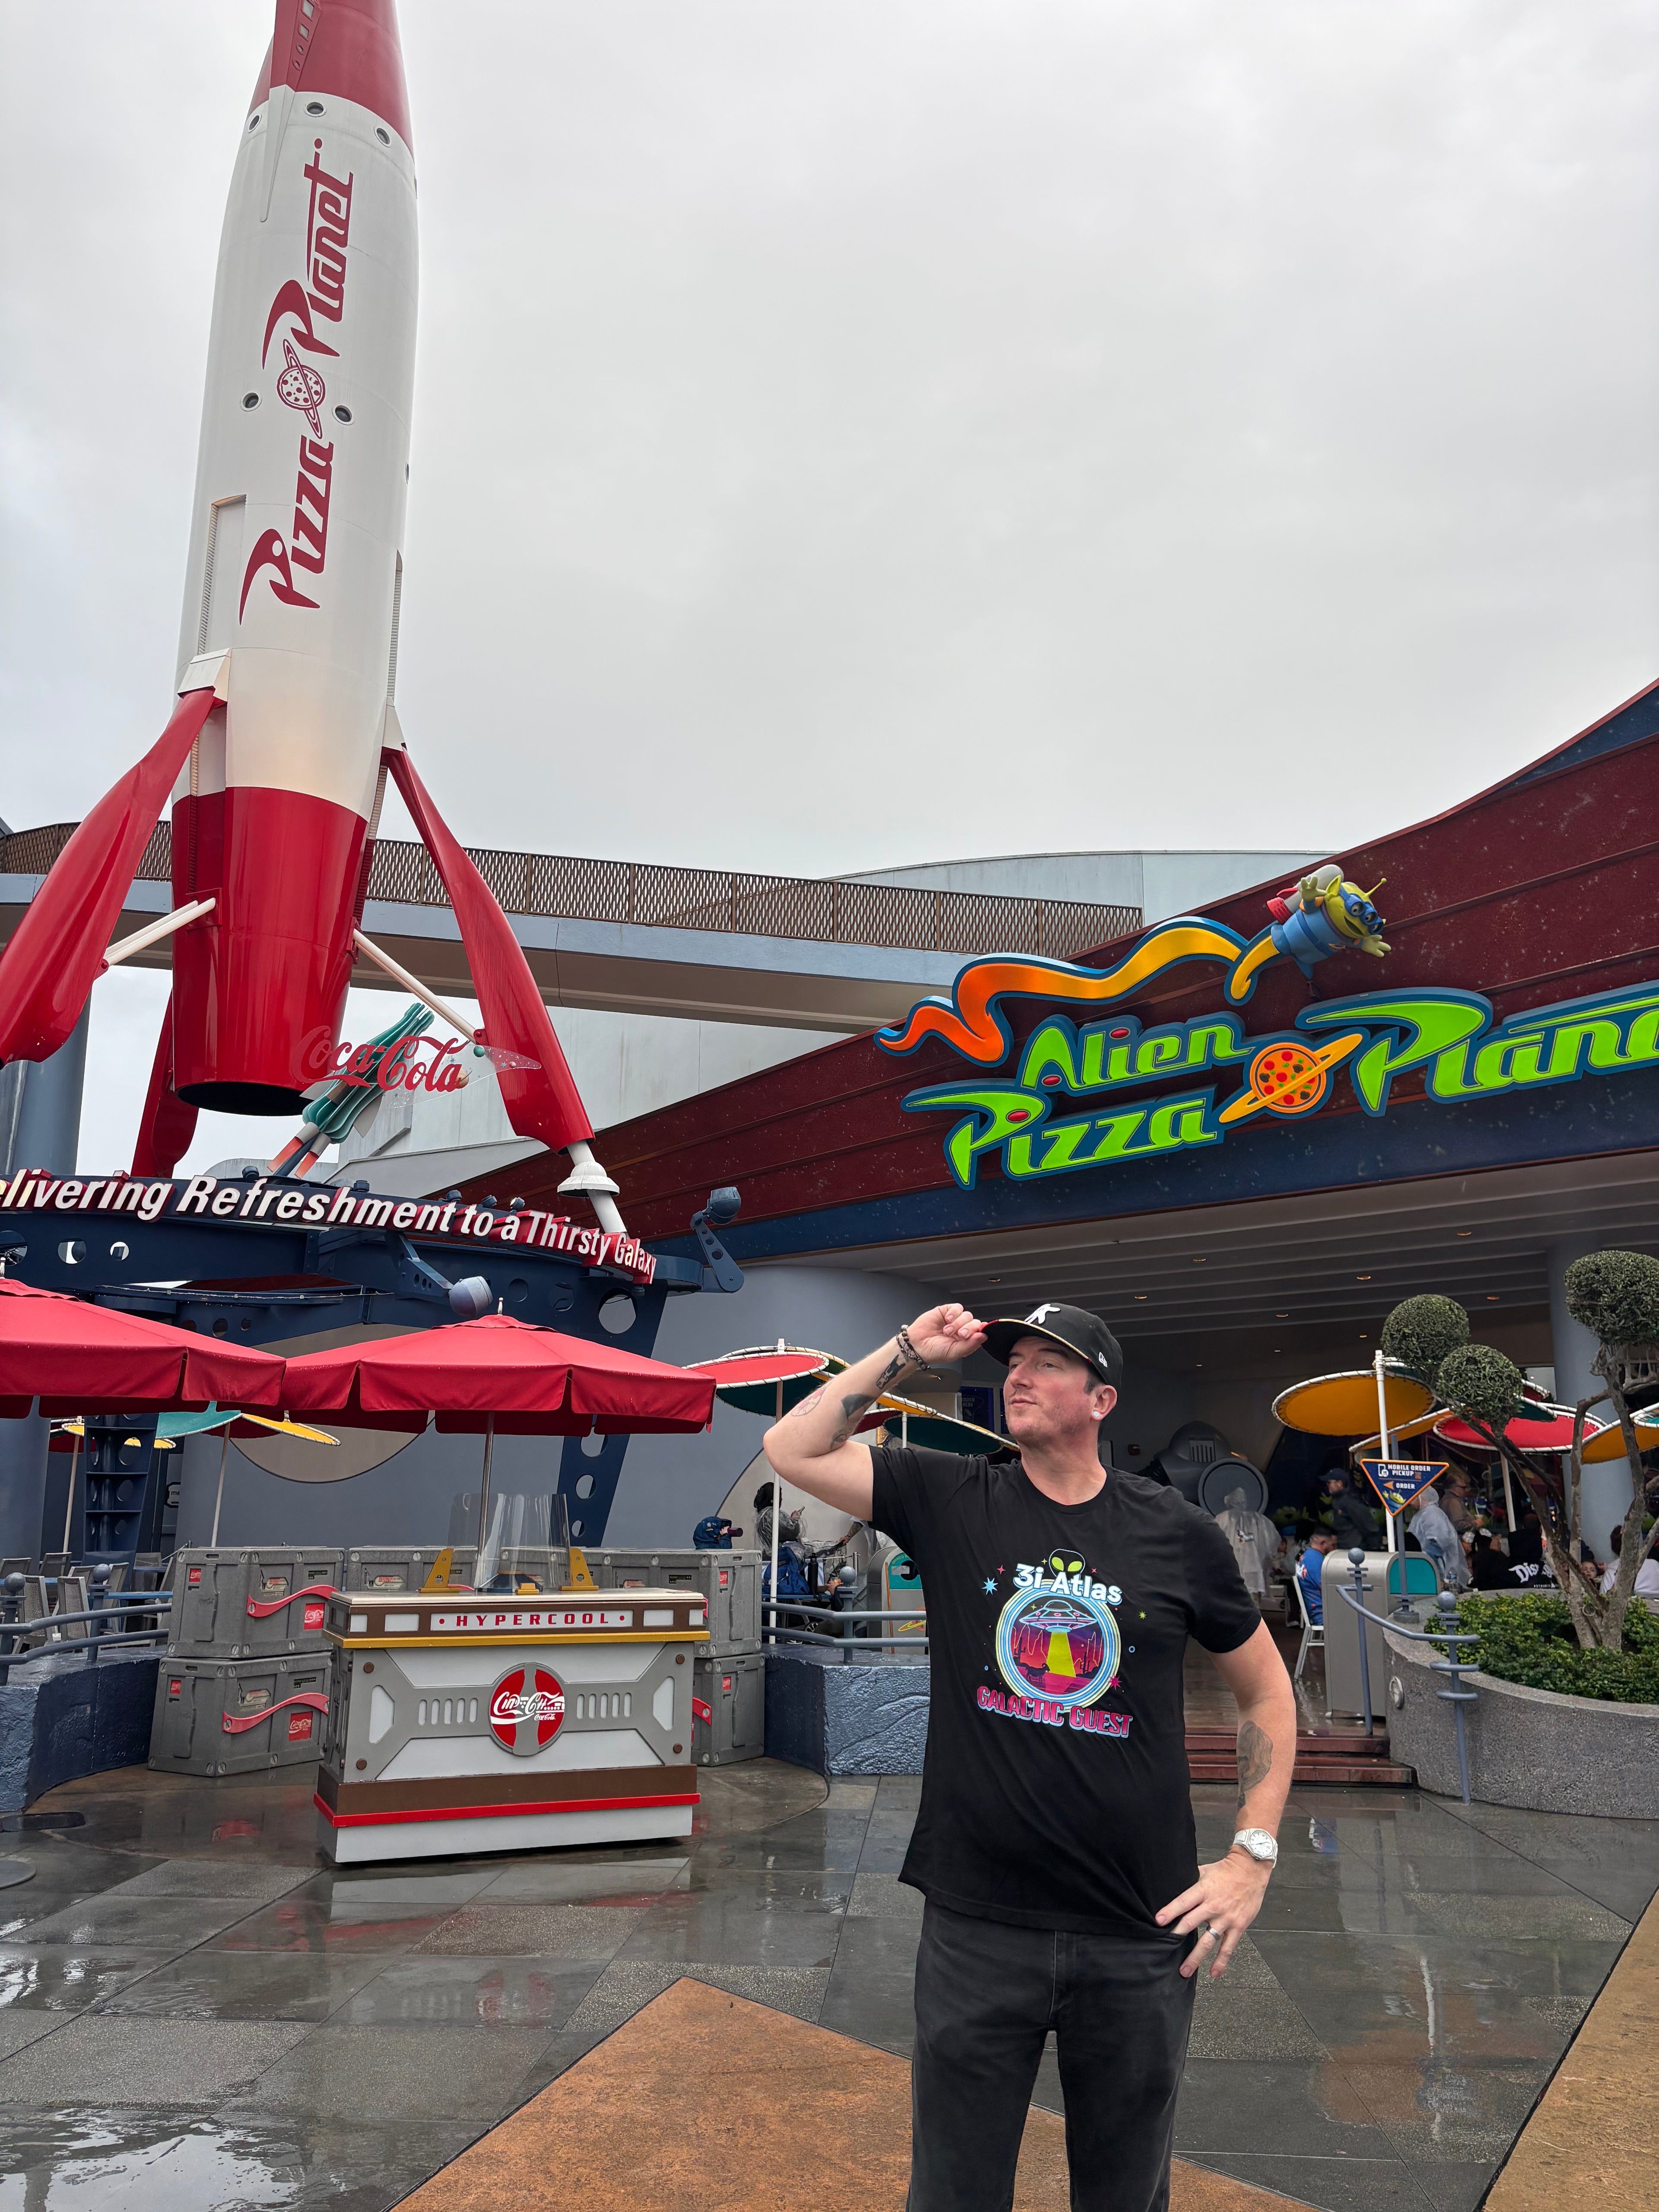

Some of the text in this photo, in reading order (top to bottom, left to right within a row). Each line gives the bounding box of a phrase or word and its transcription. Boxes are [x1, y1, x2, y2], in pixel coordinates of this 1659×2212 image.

[263, 137, 353, 370] Planet
[239, 435, 334, 625] Pizza
[290, 1025, 471, 1092] Coca-Cola
[1022, 1025, 1255, 1090] Alien
[906, 1091, 1217, 1185] Pizza
[0, 1168, 657, 1284] livering Refreshment to a Thirsty Galaxy
[1013, 1563, 1122, 1606] 3i Atlas
[456, 1613, 609, 1626] HYPERCOOL
[977, 1685, 1133, 1738] GALACTIC GUEST
